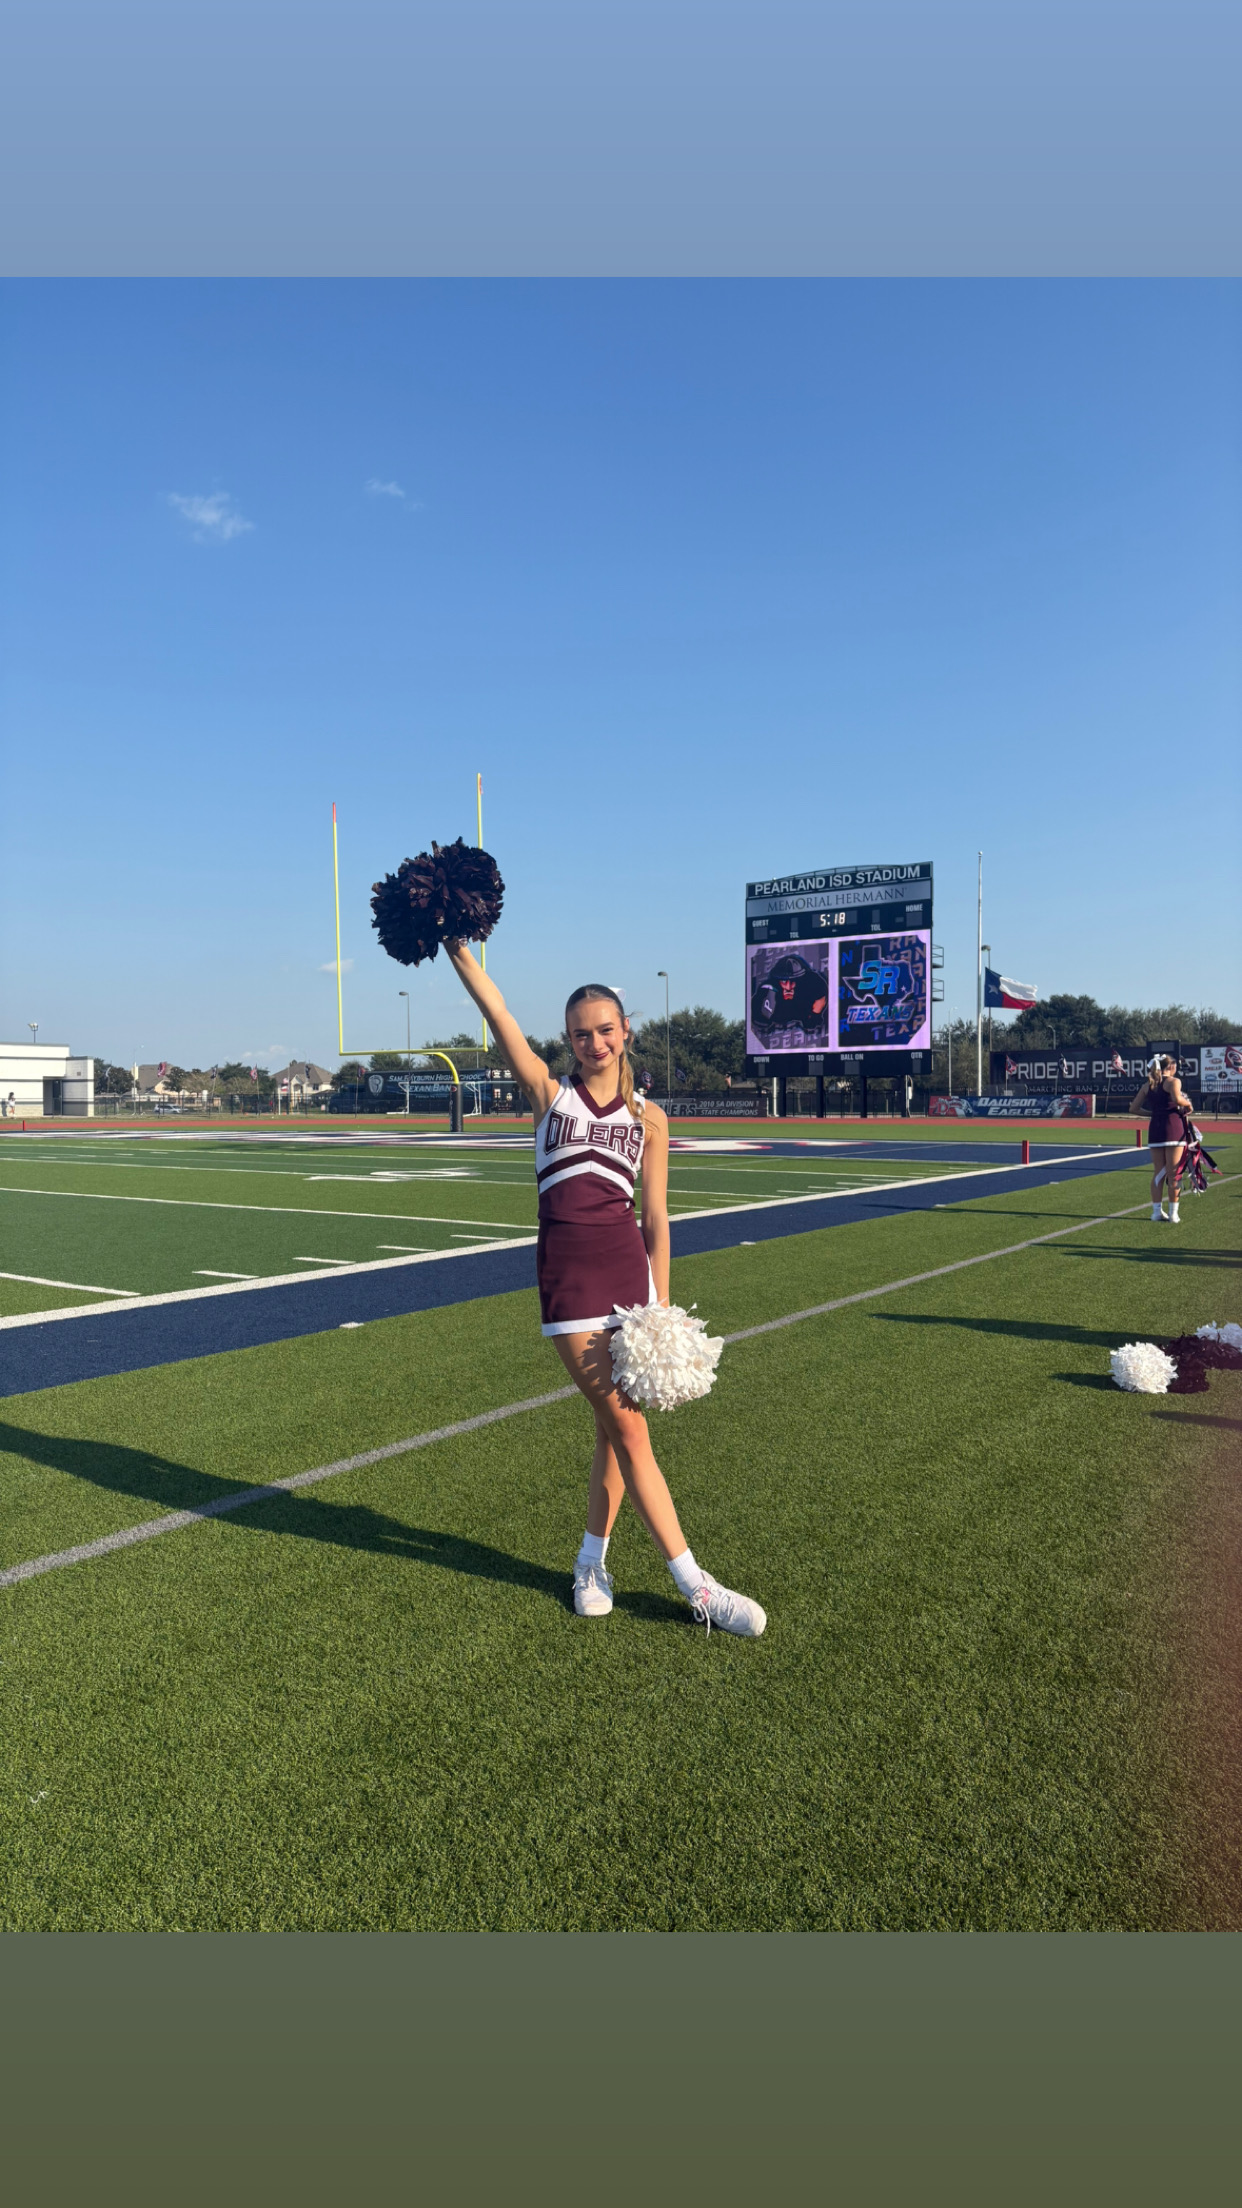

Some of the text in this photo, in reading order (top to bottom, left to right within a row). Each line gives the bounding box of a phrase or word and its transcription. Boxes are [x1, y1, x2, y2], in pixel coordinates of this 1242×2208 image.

[755, 865, 921, 896] PEARLAND ISD STADIUM
[767, 888, 905, 913] MEMORIAL HERMANN
[905, 903, 923, 913] HOME
[752, 919, 770, 928] GUEST
[819, 911, 846, 927] 5:18
[858, 960, 900, 995] SR
[847, 1004, 915, 1023] TEXANS
[699, 1100, 715, 1108] 2010
[726, 1100, 754, 1108] DIVISION
[977, 1097, 1038, 1107] DAWSON
[987, 1107, 1042, 1116] EAGLES
